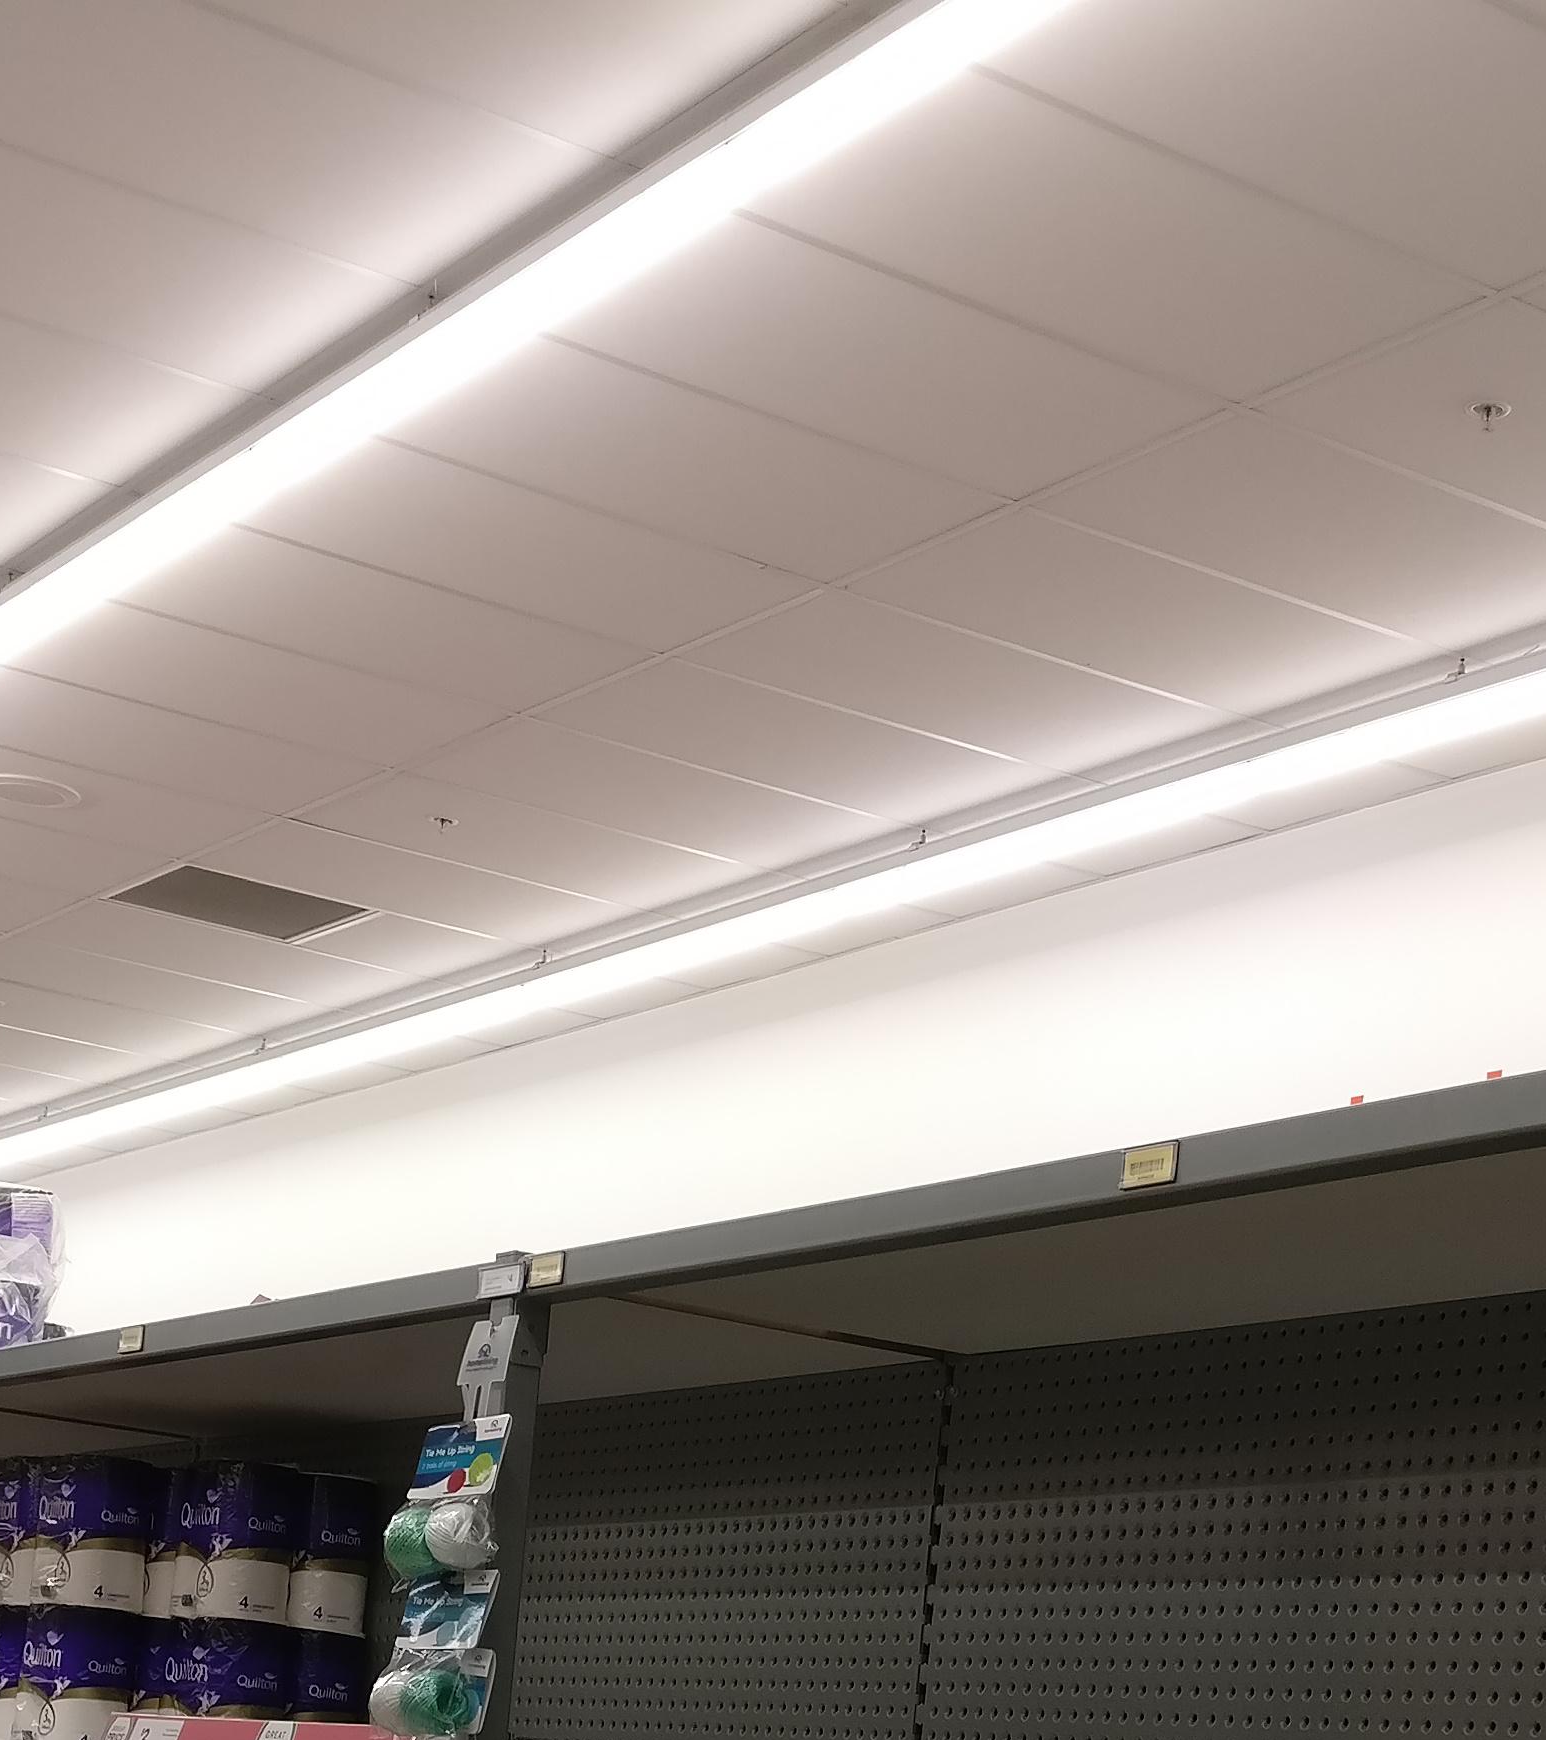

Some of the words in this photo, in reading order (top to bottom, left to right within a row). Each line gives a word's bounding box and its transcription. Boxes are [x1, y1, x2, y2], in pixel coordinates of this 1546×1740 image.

[39, 1495, 75, 1522] Quilton
[181, 1502, 220, 1529] Quilton
[101, 1510, 140, 1525] Quilton
[248, 1516, 287, 1535] Quilton
[321, 1530, 361, 1546] Quilton
[94, 1585, 104, 1598] 4
[239, 1596, 249, 1609] 4
[313, 1606, 323, 1619] 4
[23, 1640, 63, 1668] Quilton
[88, 1660, 127, 1676] Quilton
[165, 1656, 209, 1683] Quilton
[236, 1674, 278, 1692] Quilton
[309, 1684, 348, 1701] Quilton
[265, 1729, 287, 1739] GREAT
